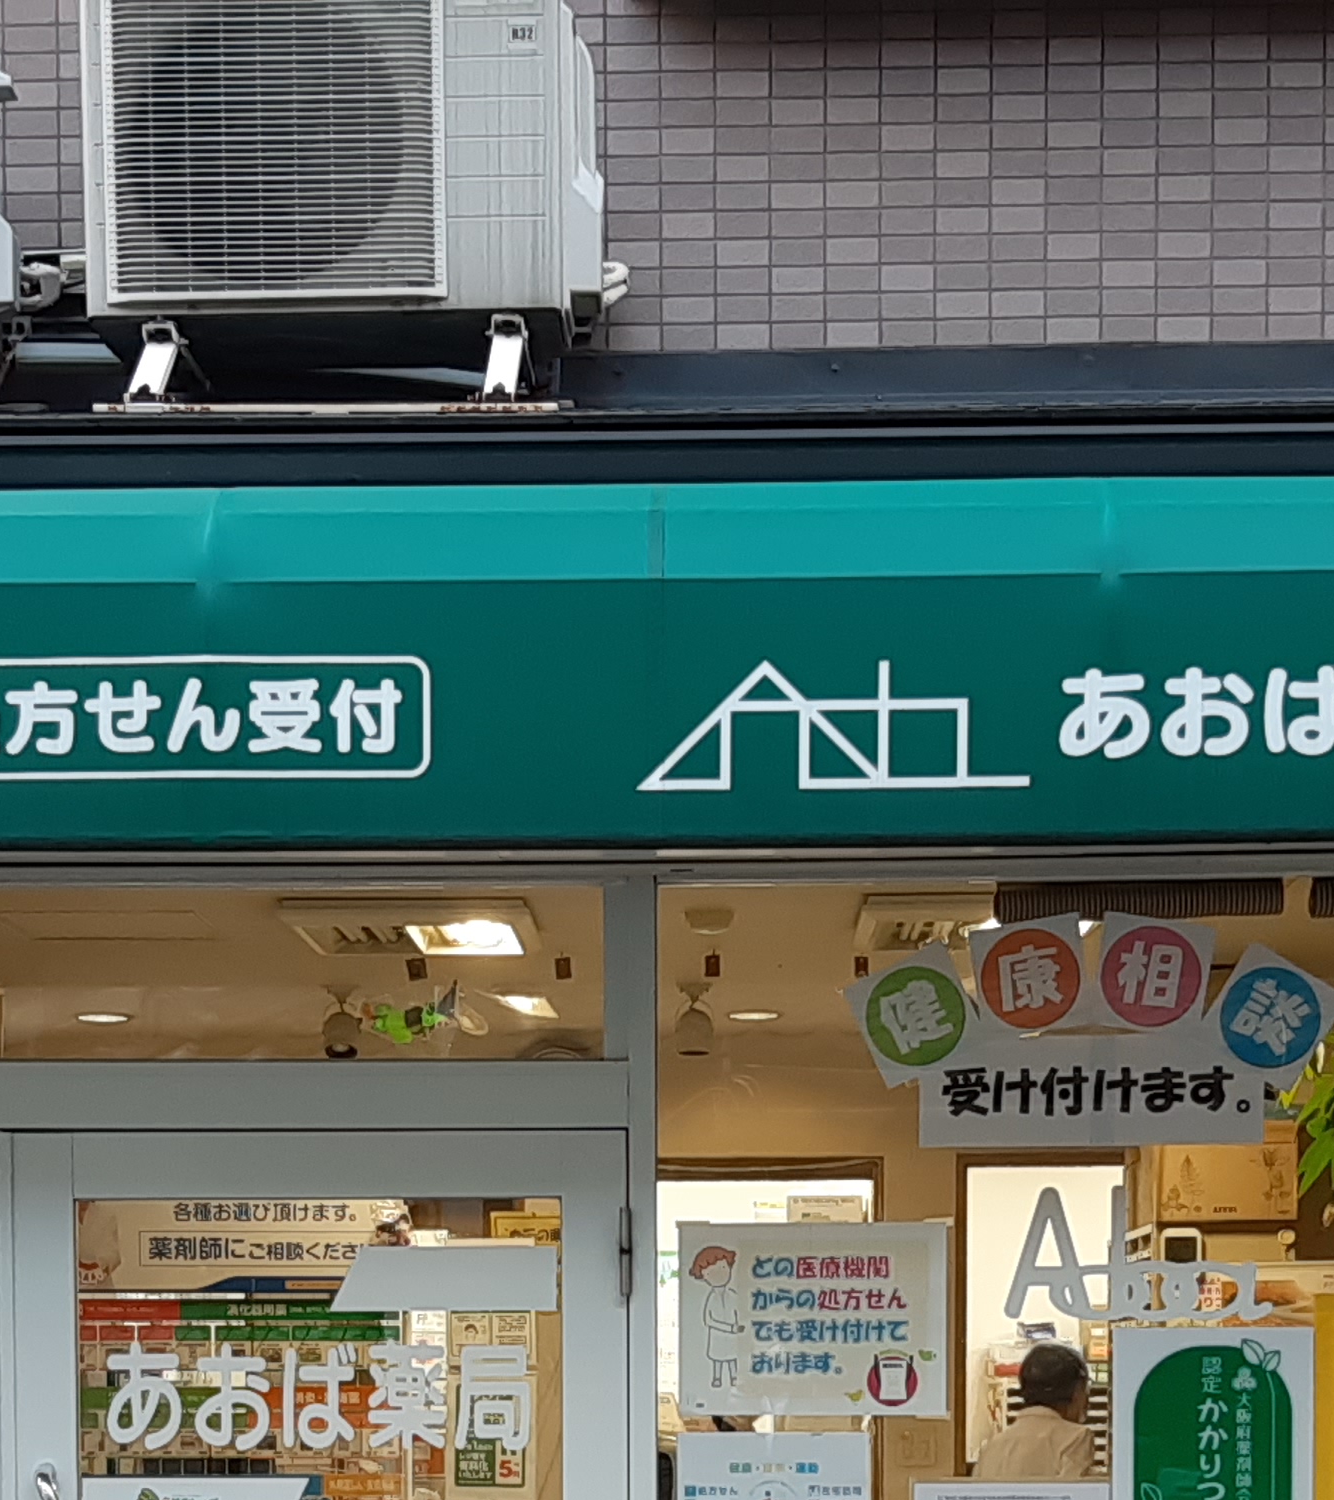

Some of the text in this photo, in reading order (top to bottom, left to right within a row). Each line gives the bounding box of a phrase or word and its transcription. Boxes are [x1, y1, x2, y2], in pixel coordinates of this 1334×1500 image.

[879, 940, 1314, 1058] 健康相談
[942, 1066, 1251, 1117] 受け付けます。
[173, 1202, 357, 1222] 各種お選び頂けます。
[148, 1237, 364, 1261] 薬剤師にご相談くださ
[752, 1256, 890, 1280] どの医療機関
[751, 1289, 908, 1311] からの処方せん
[752, 1320, 910, 1343] でも受け付けて
[751, 1352, 844, 1376] おります。
[106, 1342, 531, 1451] あおば薬局
